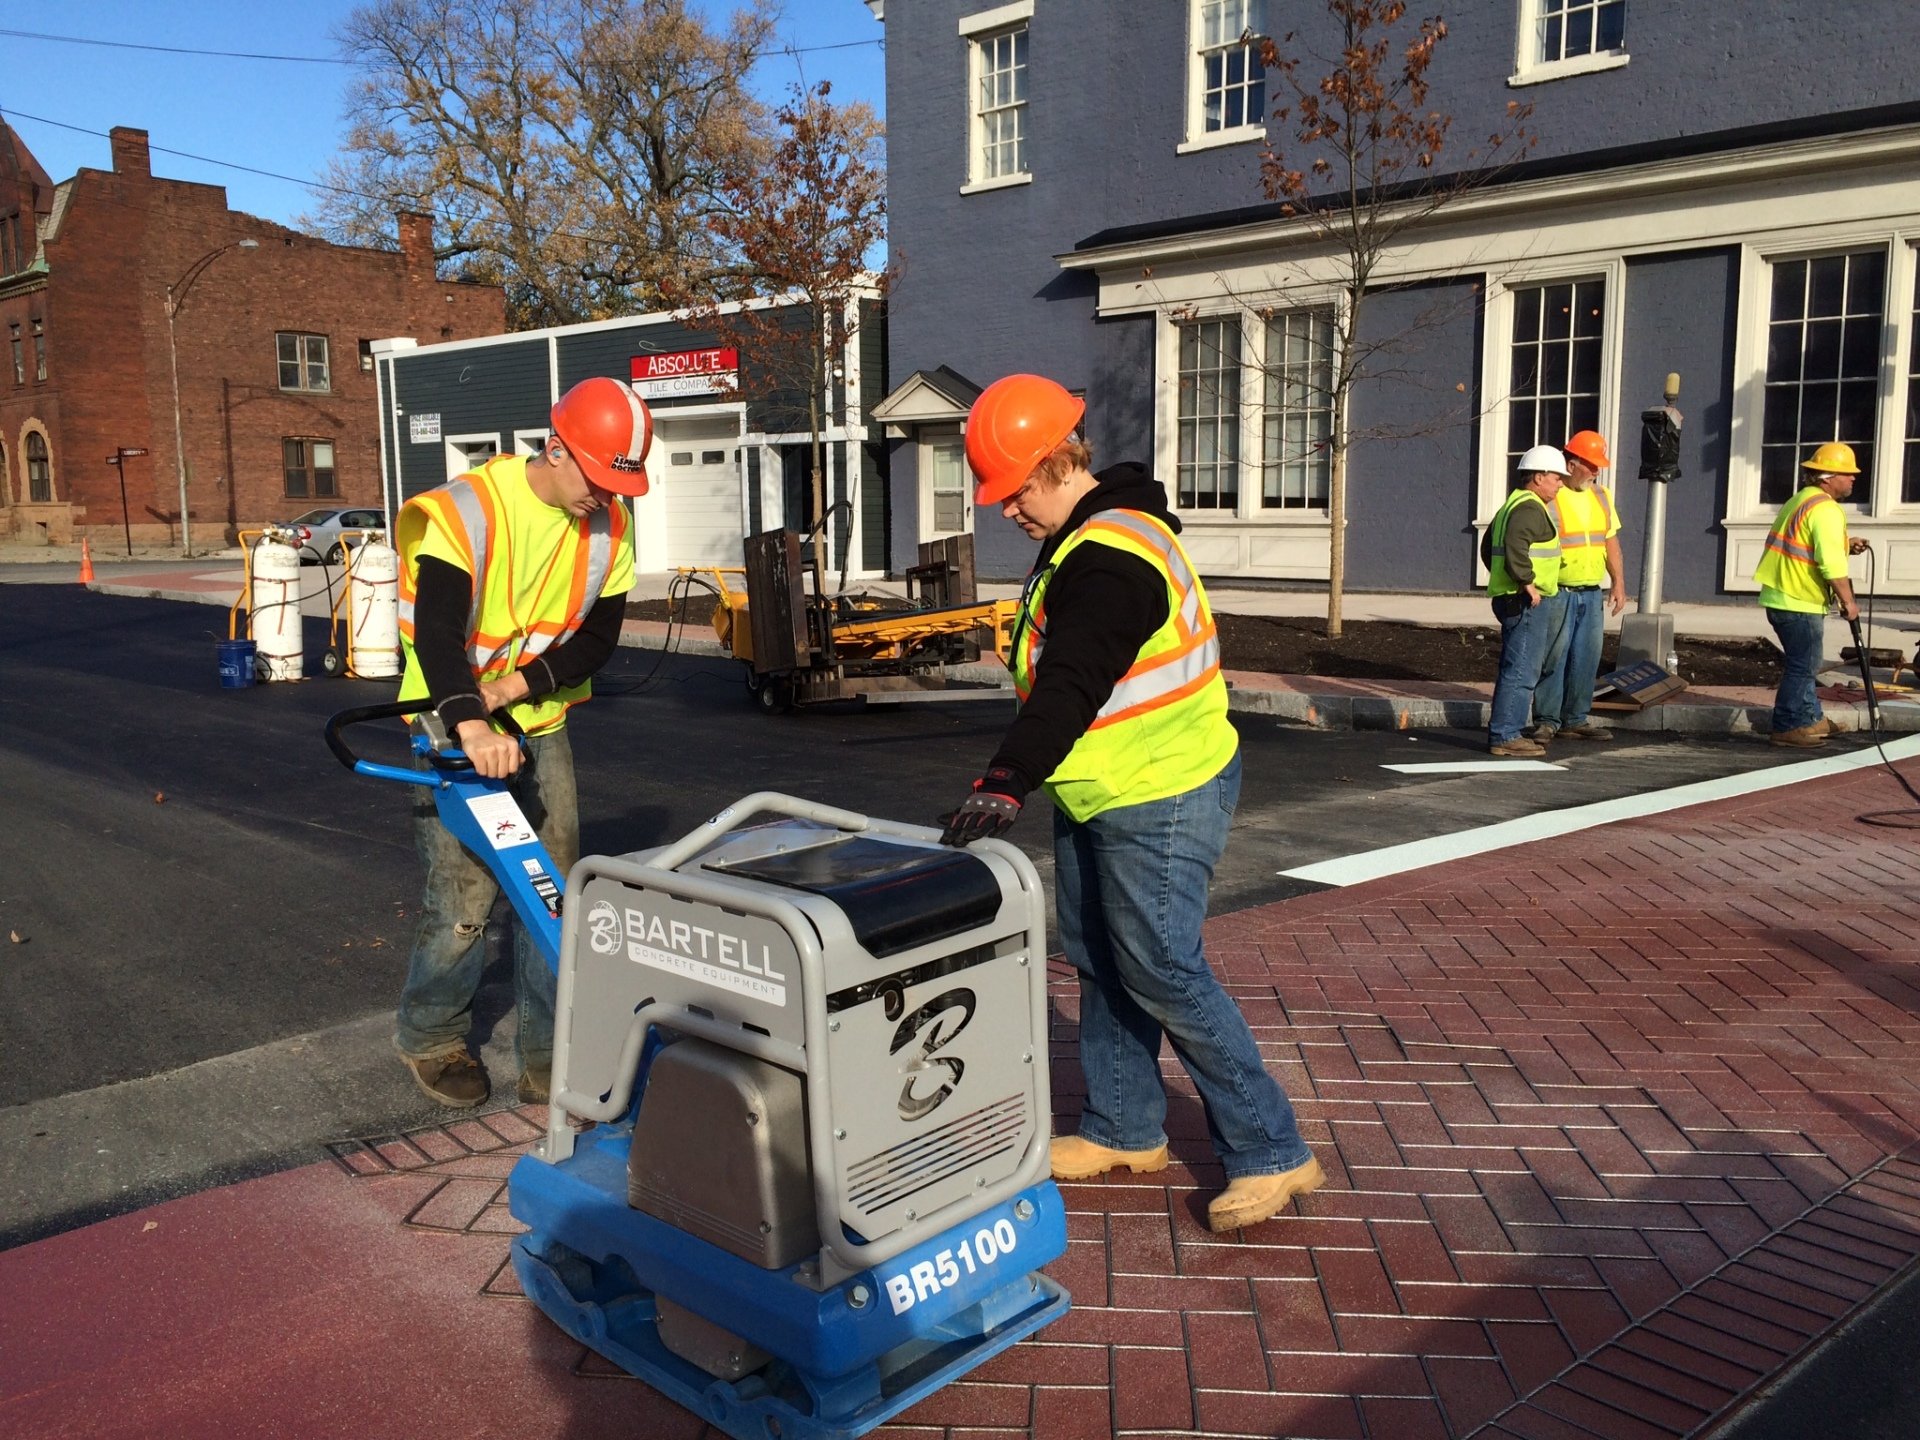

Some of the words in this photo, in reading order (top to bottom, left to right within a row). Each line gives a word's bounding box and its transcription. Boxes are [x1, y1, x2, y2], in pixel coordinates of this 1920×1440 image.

[647, 351, 721, 376] ABSOLUTE
[648, 382, 668, 393] TILE
[673, 377, 724, 391] COMPA
[625, 907, 786, 982] BARTELL
[634, 947, 695, 973] CONCRETE
[702, 966, 778, 996] EQUIPMENT
[885, 1218, 1017, 1317] BR5100
